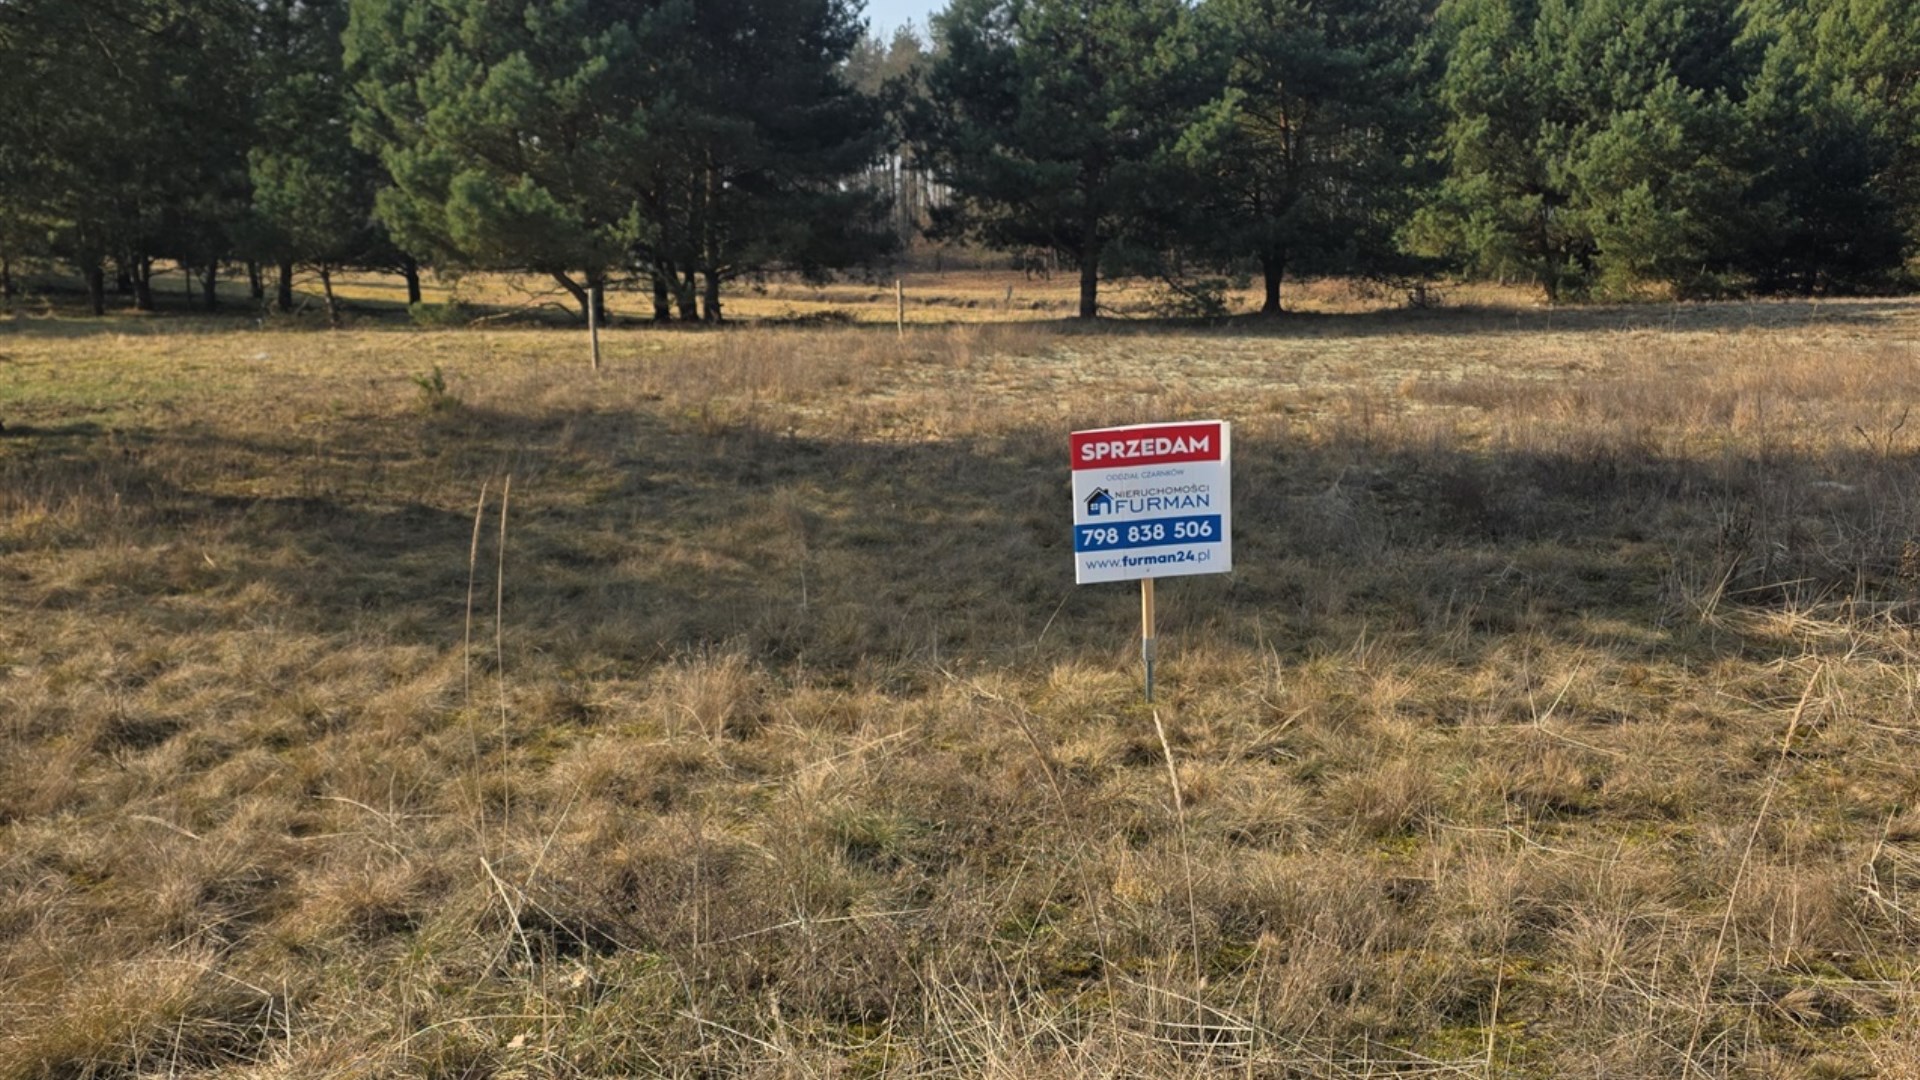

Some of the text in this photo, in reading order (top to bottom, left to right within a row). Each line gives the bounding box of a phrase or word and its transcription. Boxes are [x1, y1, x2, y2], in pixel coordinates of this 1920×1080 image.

[1081, 435, 1209, 461] SPRZEDAM
[1115, 483, 1209, 498] NIERUCHOMOŚCI
[1115, 494, 1210, 515] FURMAN
[1082, 520, 1212, 546] 798 838 506
[1086, 549, 1211, 569] www.furman24.pl
